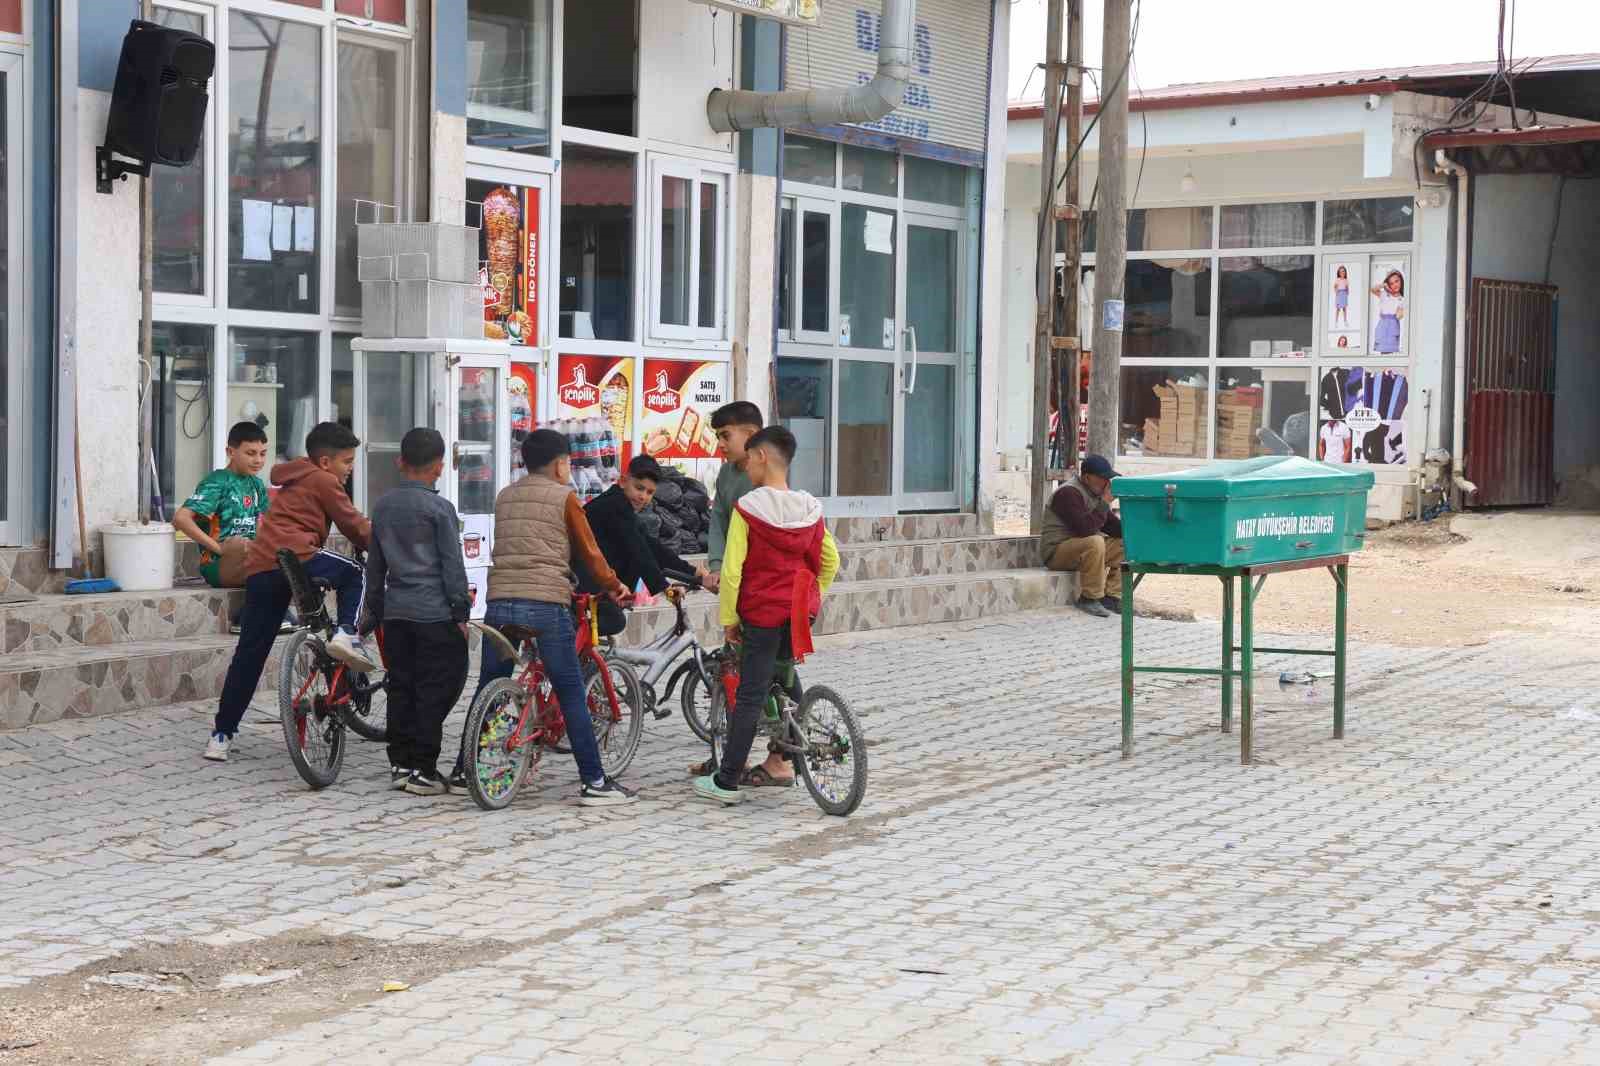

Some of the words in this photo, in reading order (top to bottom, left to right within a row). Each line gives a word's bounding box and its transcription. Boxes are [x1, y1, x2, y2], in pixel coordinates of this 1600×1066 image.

[527, 232, 537, 277] DÖNER
[527, 280, 536, 302] İBO
[700, 380, 716, 392] SATIŞ
[695, 394, 721, 403] NOKTASI
[1235, 519, 1256, 539] HATAY
[1257, 512, 1297, 541] BÜYÜKŞEHİR
[1299, 512, 1334, 534] BELEDİYESİ
